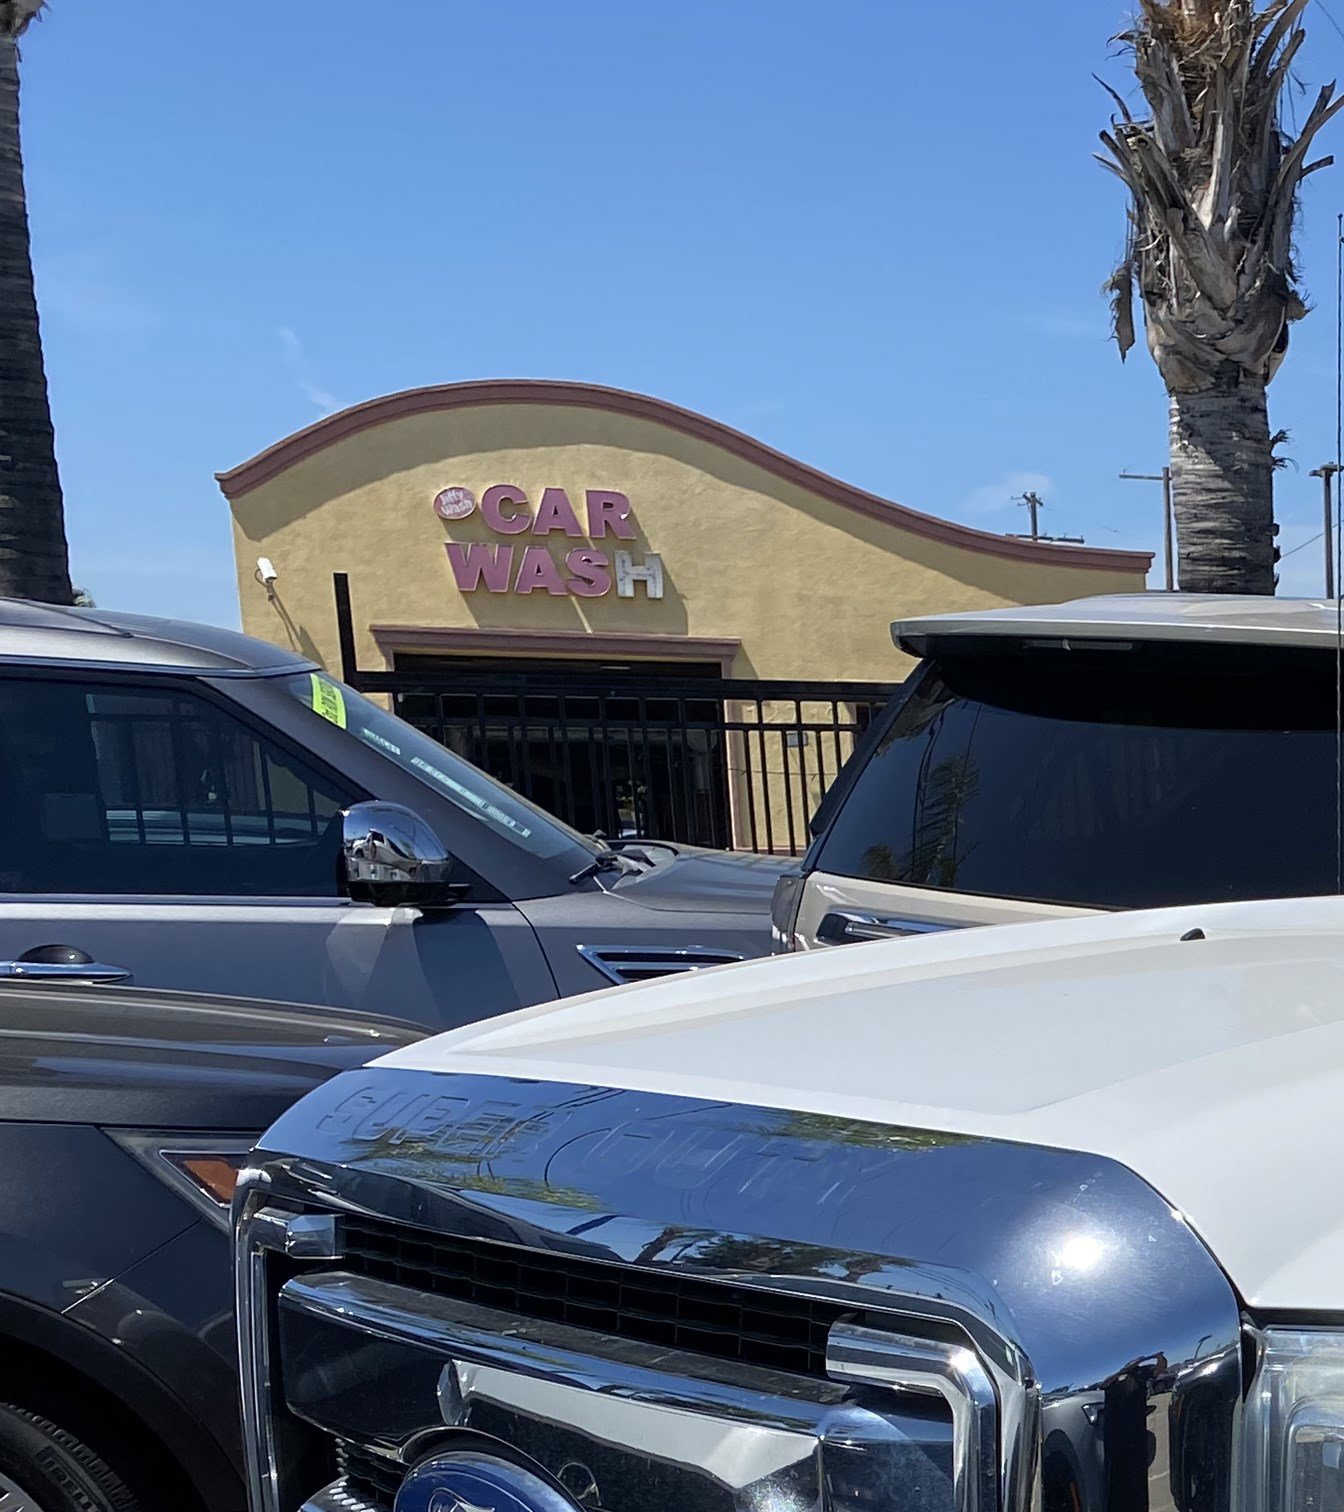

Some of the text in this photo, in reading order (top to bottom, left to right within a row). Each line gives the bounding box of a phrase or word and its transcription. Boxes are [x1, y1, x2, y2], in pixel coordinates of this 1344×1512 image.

[440, 489, 464, 506] Jiffy
[440, 500, 473, 516] Wash
[481, 483, 637, 540] CAR
[444, 541, 664, 599] WASH
[316, 1086, 573, 1158] SUPER
